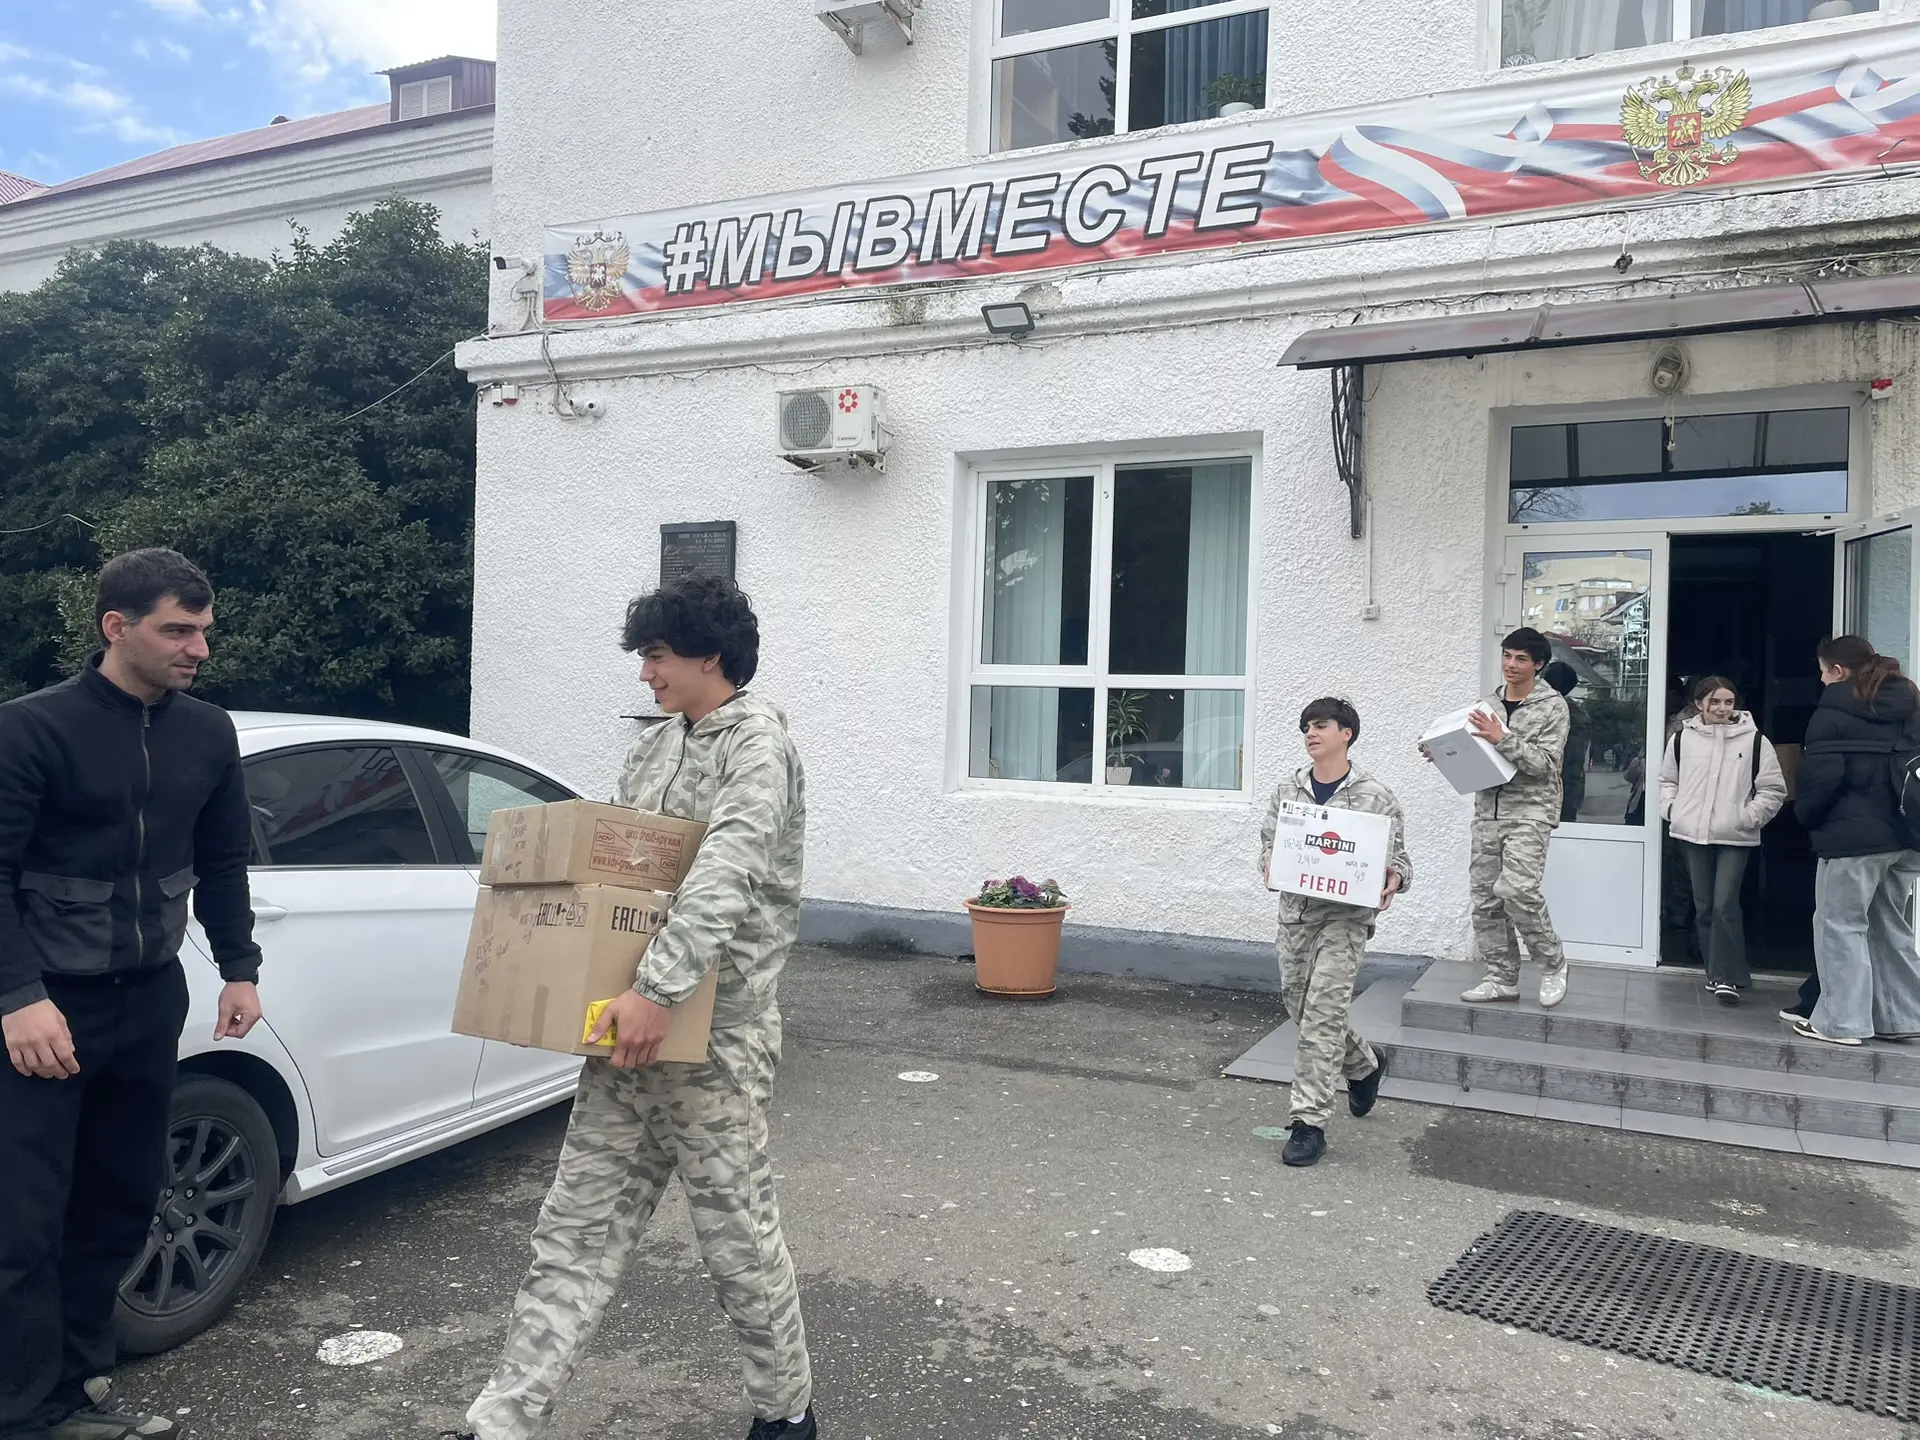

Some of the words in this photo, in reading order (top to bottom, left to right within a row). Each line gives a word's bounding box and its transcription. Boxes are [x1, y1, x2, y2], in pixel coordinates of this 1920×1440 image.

[662, 140, 1274, 297] #МЫВМЕСТЕ
[1306, 835, 1354, 852] MARTINI
[1299, 873, 1349, 896] FIERO
[611, 905, 638, 932] EAC
